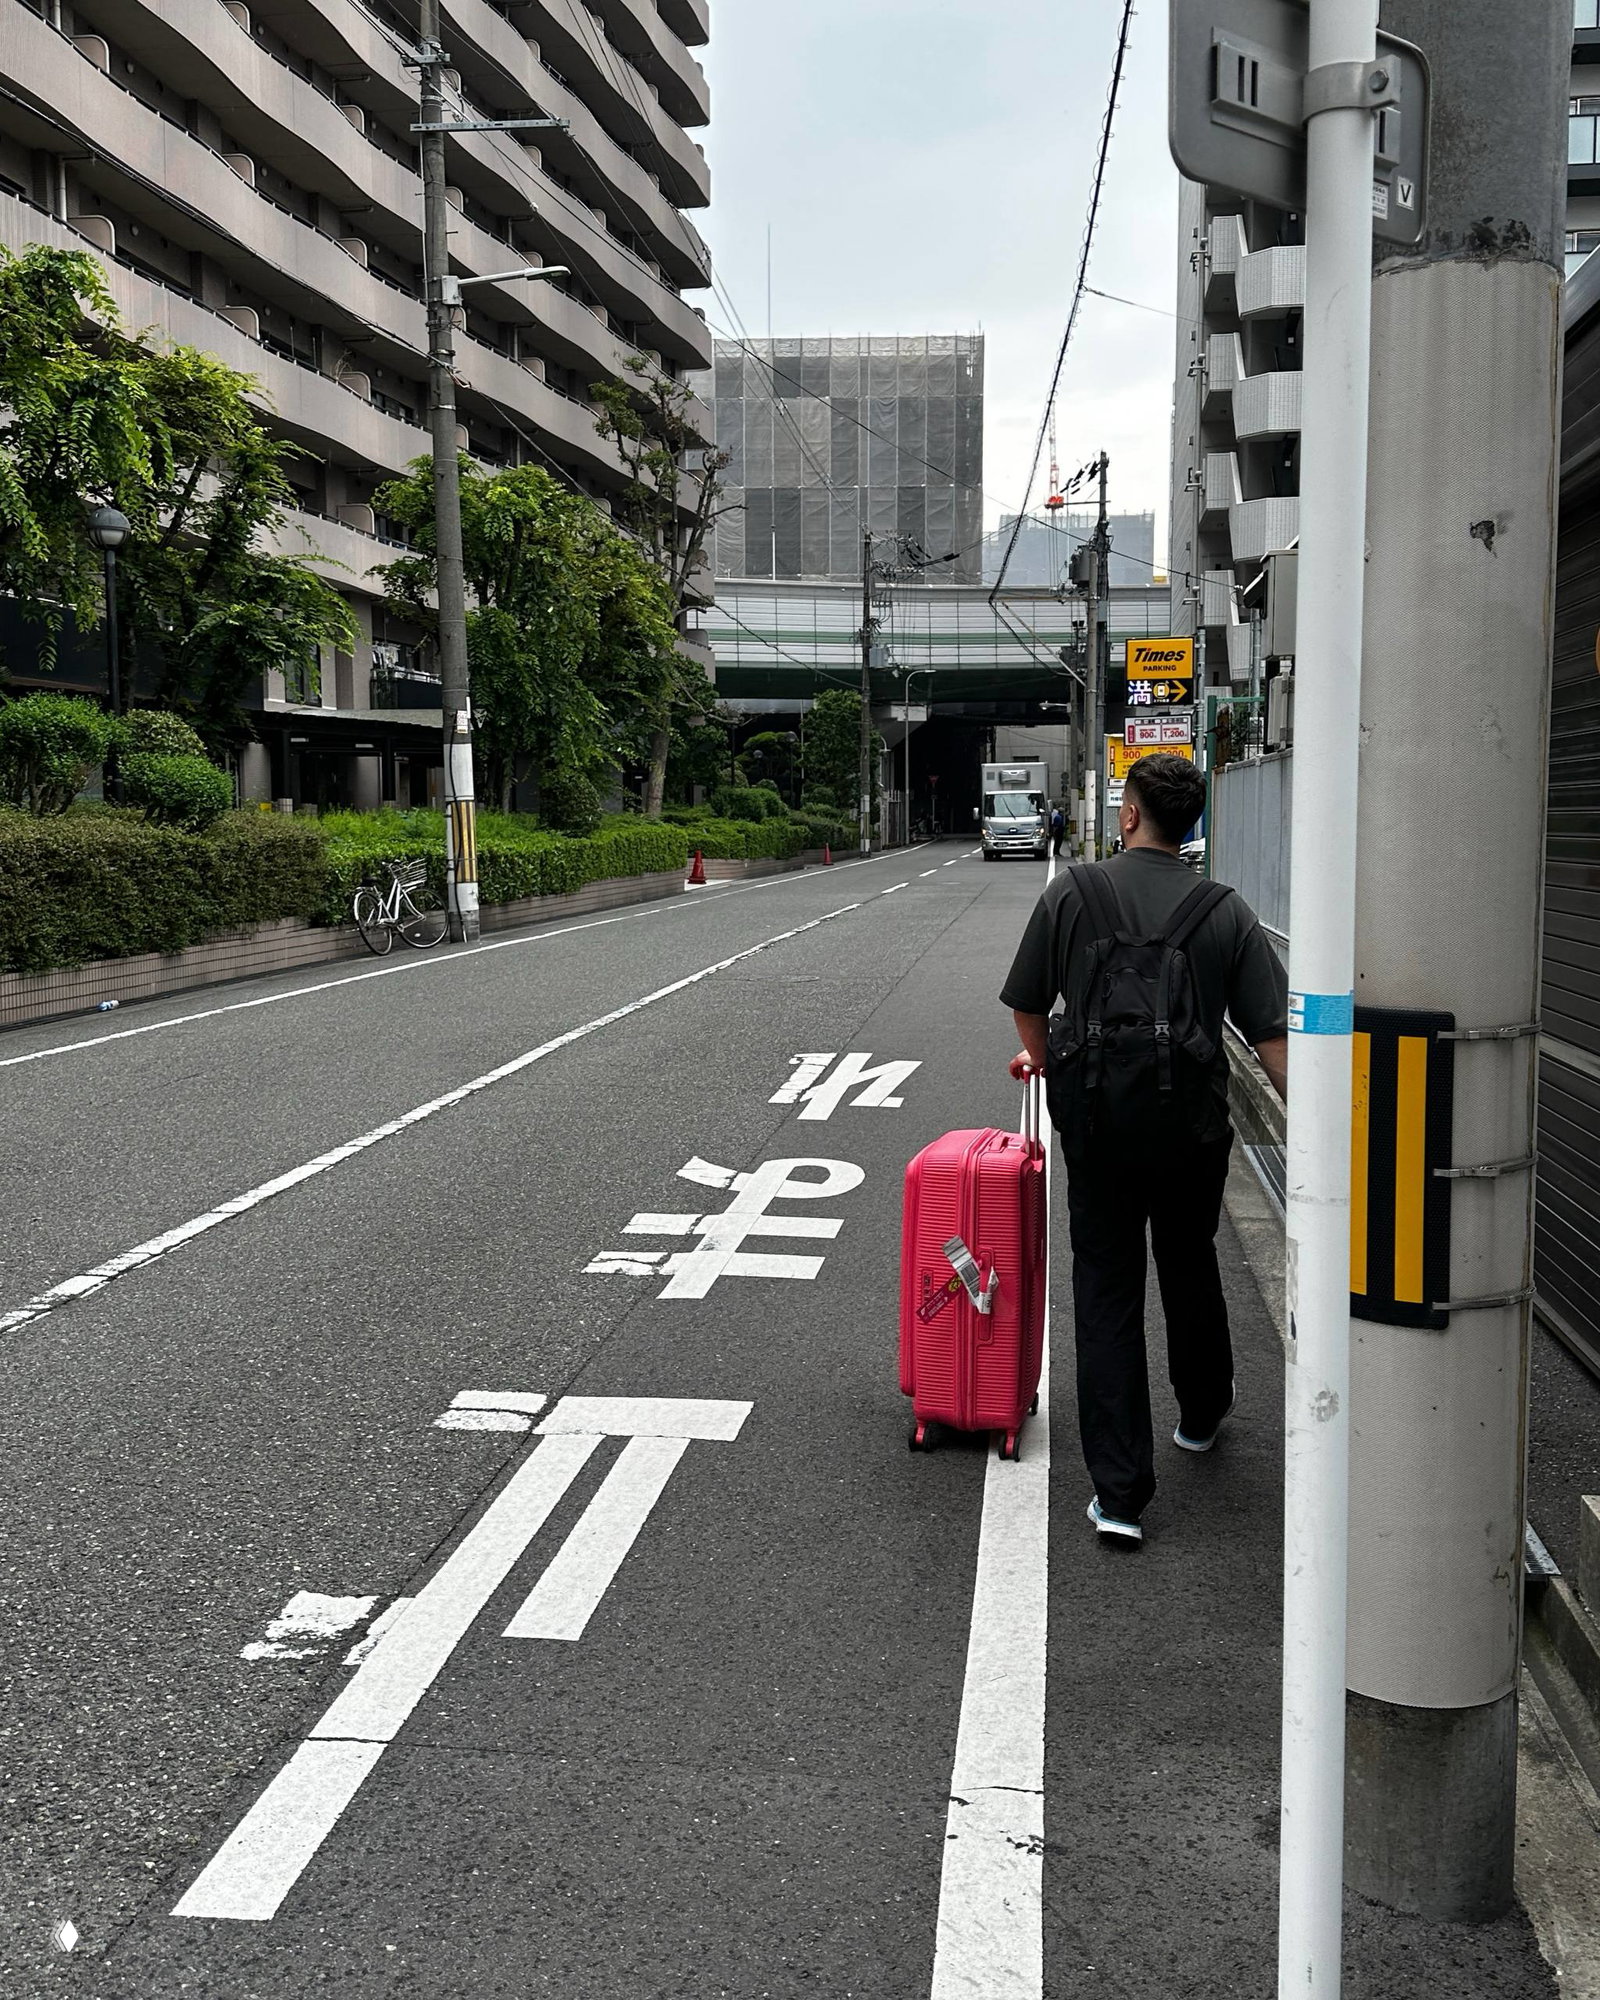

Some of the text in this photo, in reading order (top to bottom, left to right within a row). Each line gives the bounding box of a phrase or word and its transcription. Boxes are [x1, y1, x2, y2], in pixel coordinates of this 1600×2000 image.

[1134, 648, 1186, 663] Times
[1128, 680, 1153, 705] 満
[1140, 731, 1154, 739] 900
[1163, 730, 1185, 739] 1,200
[1122, 750, 1141, 759] 900
